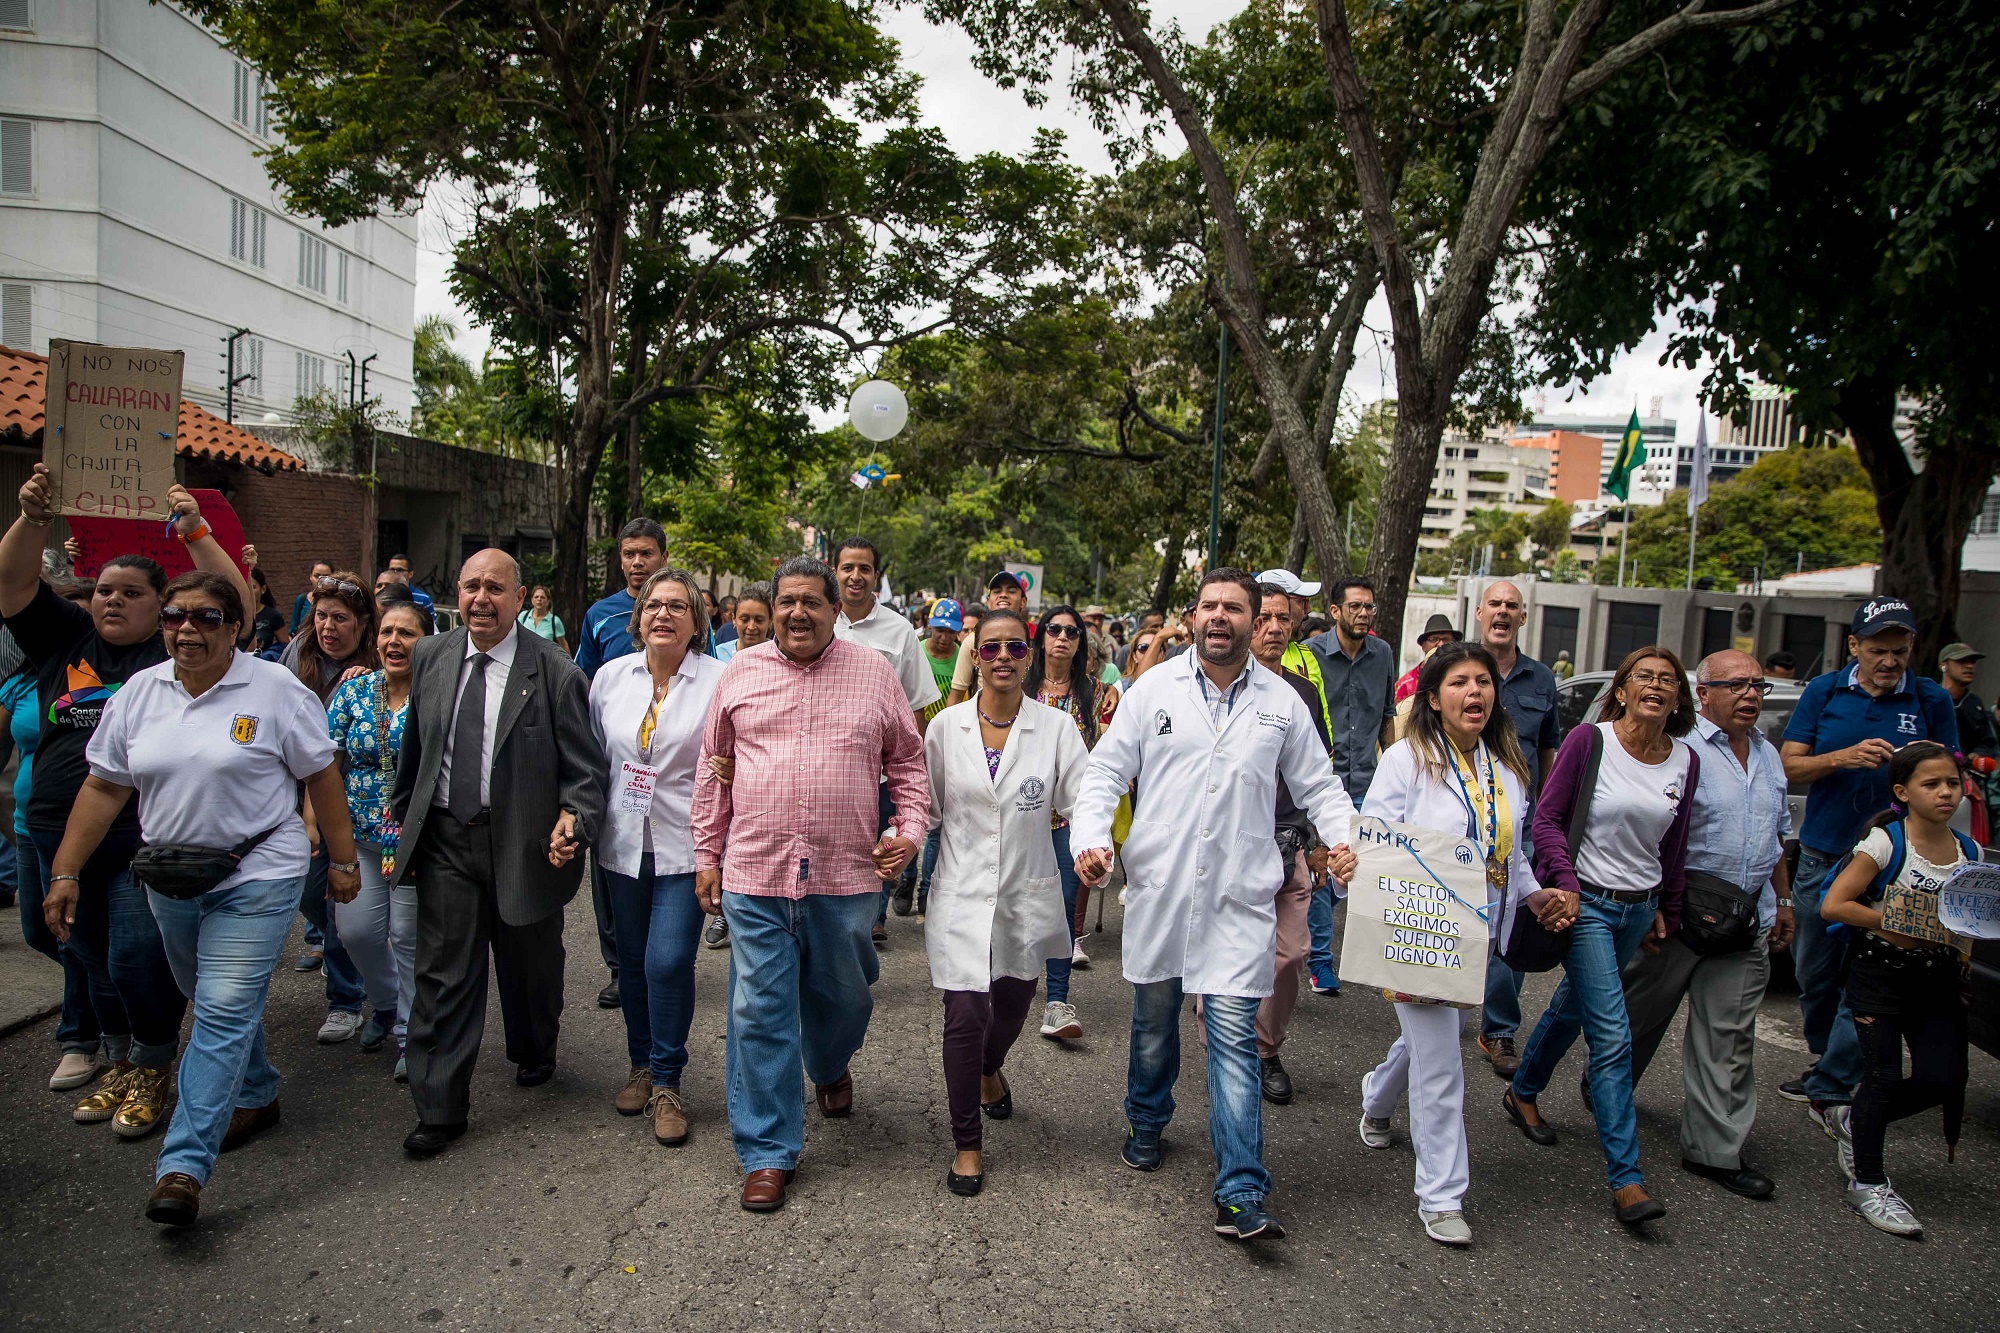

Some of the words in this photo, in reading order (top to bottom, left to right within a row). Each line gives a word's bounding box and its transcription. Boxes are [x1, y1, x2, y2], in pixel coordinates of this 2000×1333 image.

[59, 351, 71, 369] Y
[83, 356, 112, 371] NO
[128, 358, 174, 375] NOS
[66, 381, 171, 412] CALLARAN
[99, 414, 140, 432] CON
[115, 437, 138, 452] LA
[65, 454, 143, 473] CAJITA
[110, 475, 149, 491] DEL
[75, 491, 156, 517] CLAP
[1863, 601, 1909, 623] Leones
[60, 716, 71, 724] de
[1379, 876, 1395, 892] EL
[1399, 880, 1456, 903] SECTOR
[1951, 878, 1970, 888] SE
[1397, 896, 1447, 916] SALUD
[1944, 893, 1954, 905] EN
[1384, 908, 1460, 935] EXIGIMOS
[1394, 929, 1455, 952] SUELDO
[1385, 945, 1438, 965] DIGNO
[1443, 953, 1462, 969] YA
